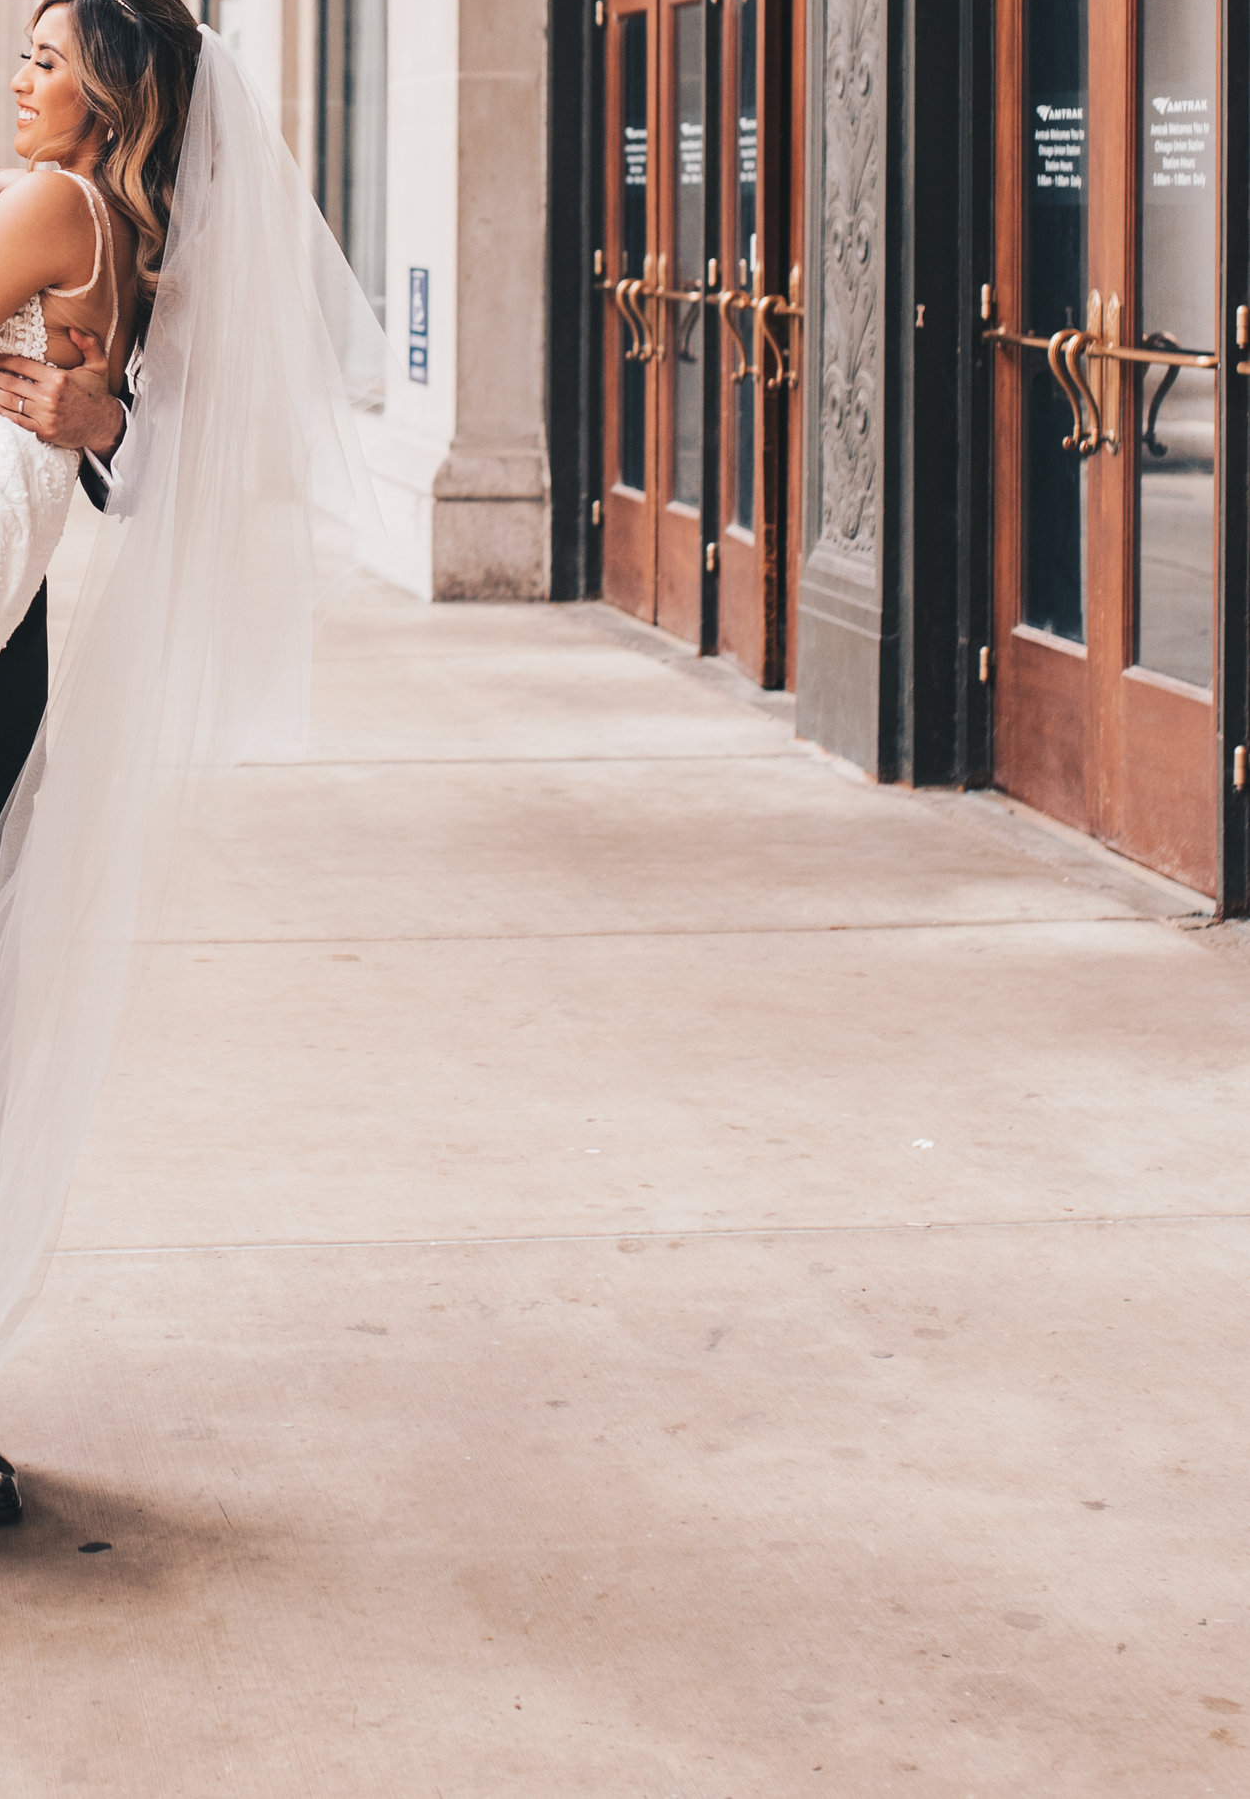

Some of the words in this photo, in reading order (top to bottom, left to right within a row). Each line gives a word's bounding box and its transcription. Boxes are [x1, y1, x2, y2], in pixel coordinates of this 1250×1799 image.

[1167, 99, 1208, 113] AMTRAK
[1048, 107, 1083, 121] AMTRAK
[1150, 122, 1168, 136] Amtrak
[1154, 139, 1173, 155] Chicago
[1173, 139, 1188, 152] Union
[1188, 138, 1206, 152] Station
